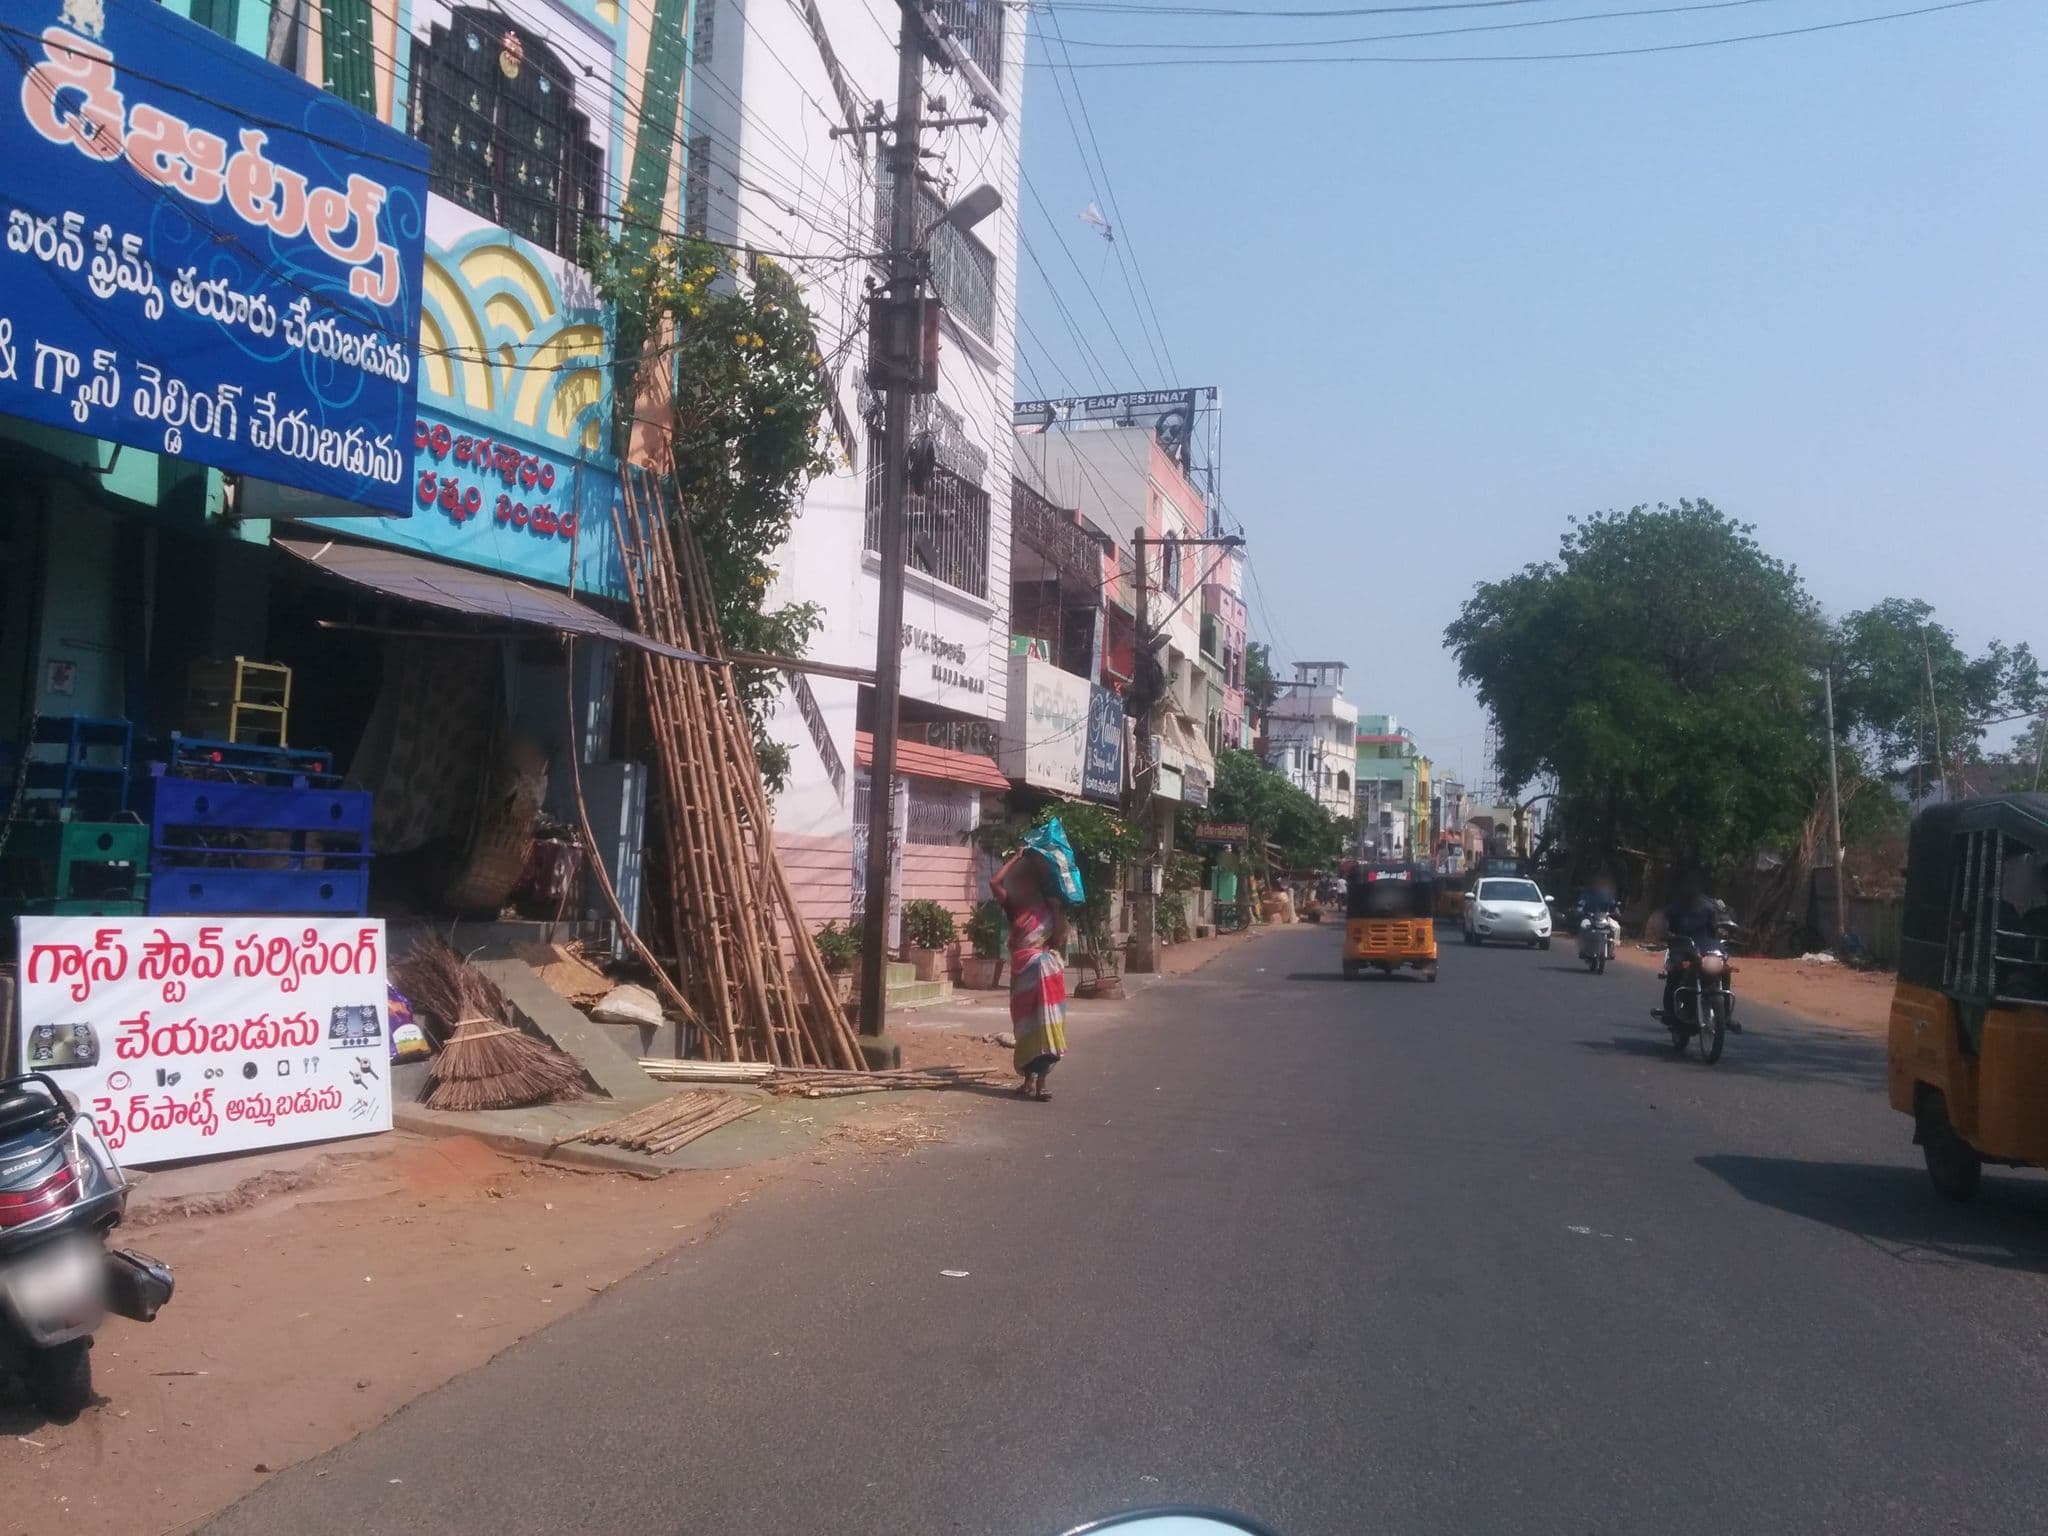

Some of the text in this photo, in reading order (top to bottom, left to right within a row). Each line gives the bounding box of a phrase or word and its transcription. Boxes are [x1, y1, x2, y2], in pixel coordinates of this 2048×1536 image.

[22, 26, 400, 306] డిజిటల్స్
[7, 209, 85, 271] ఐరన్
[170, 266, 277, 338] తయారు
[282, 296, 411, 384] చేయబడును
[34, 339, 121, 423] గ్యాస్
[133, 360, 242, 455] వెల్డింగ్
[250, 391, 403, 485] చేయబడును
[28, 928, 128, 1002] గ్యాస్
[234, 928, 378, 993] సర్విసింగ్
[115, 1011, 320, 1060] చేయబడును
[226, 1085, 343, 1127] అమ్మబడును
